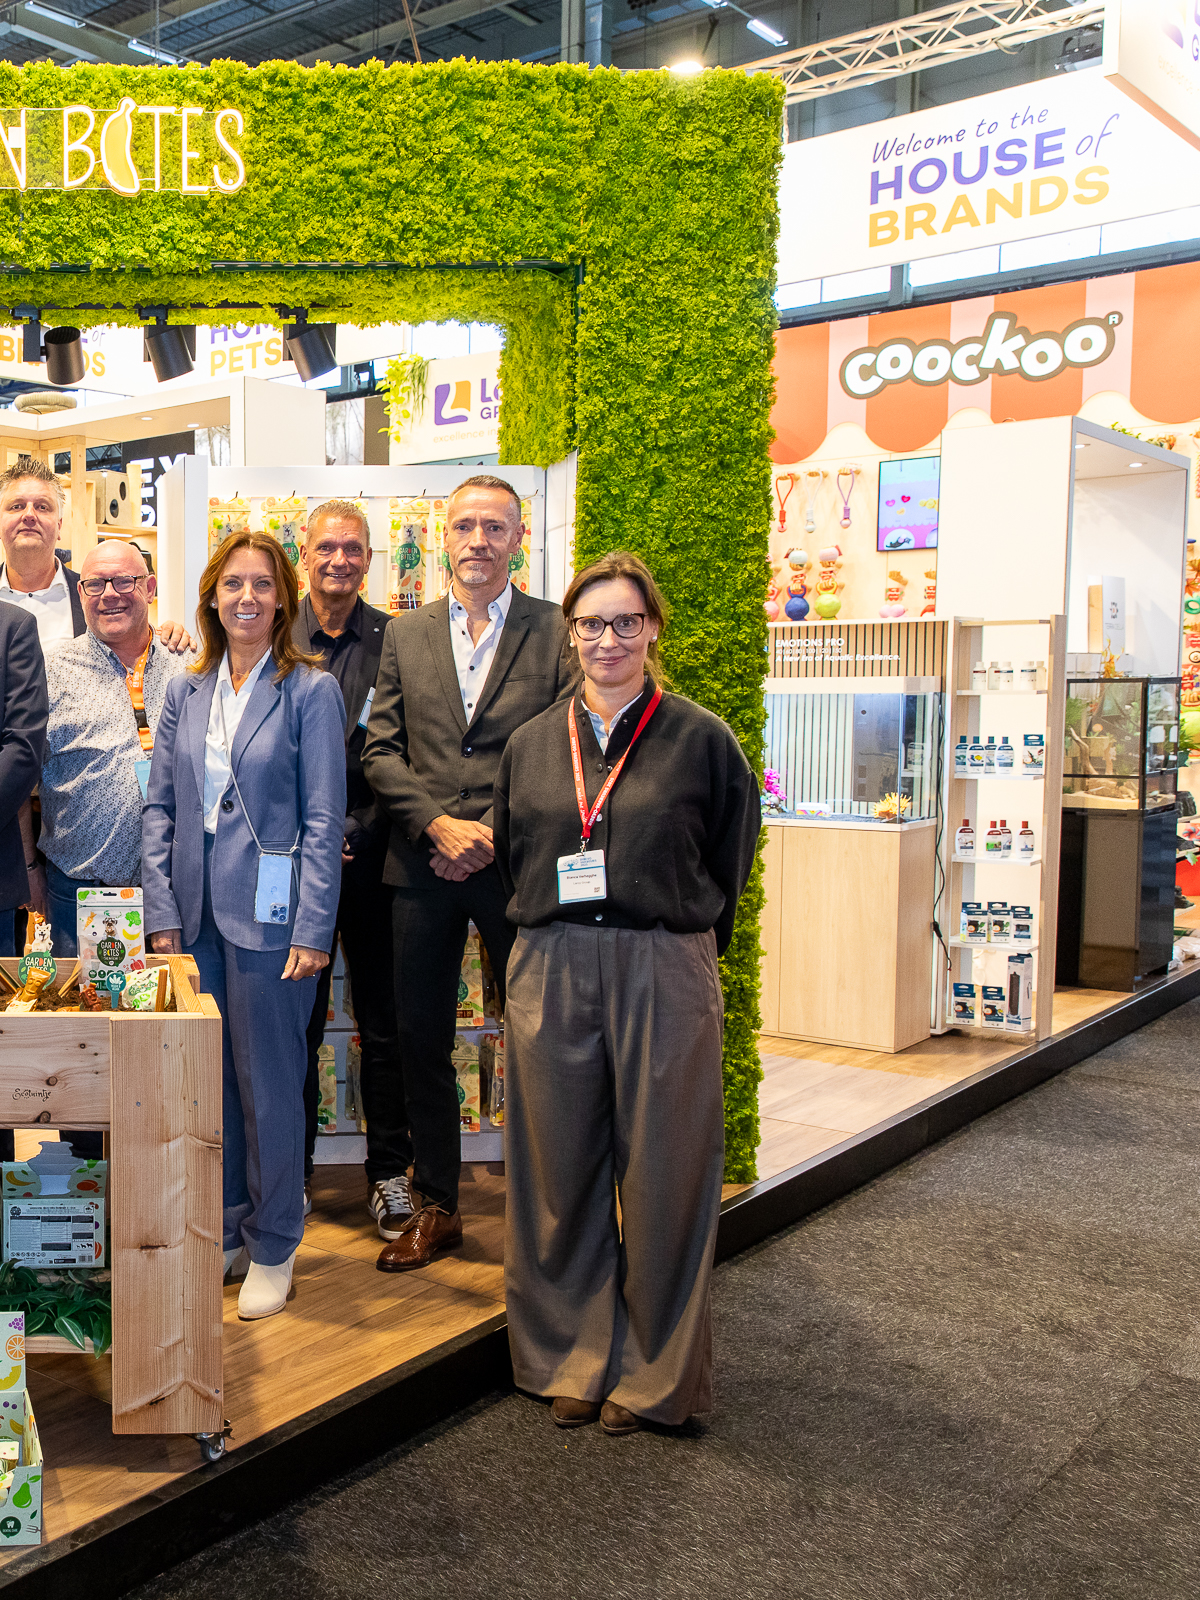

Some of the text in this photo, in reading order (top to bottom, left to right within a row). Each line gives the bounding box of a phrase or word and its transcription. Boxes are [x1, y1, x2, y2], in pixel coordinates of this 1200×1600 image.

[872, 105, 1050, 163] Welcome to the
[63, 97, 246, 196] BITES
[869, 112, 1121, 206] HOUSE of
[867, 165, 1110, 248] BRANDS
[210, 337, 282, 377] PETS
[433, 430, 485, 444] excellence
[775, 637, 845, 648] EMOTIONS PRO
[814, 654, 824, 662] of
[823, 654, 854, 663] Aquatic
[855, 653, 902, 661] Excellence.
[100, 941, 122, 949] GARDEN
[103, 948, 120, 957] BITES
[25, 956, 53, 968] GARDEN
